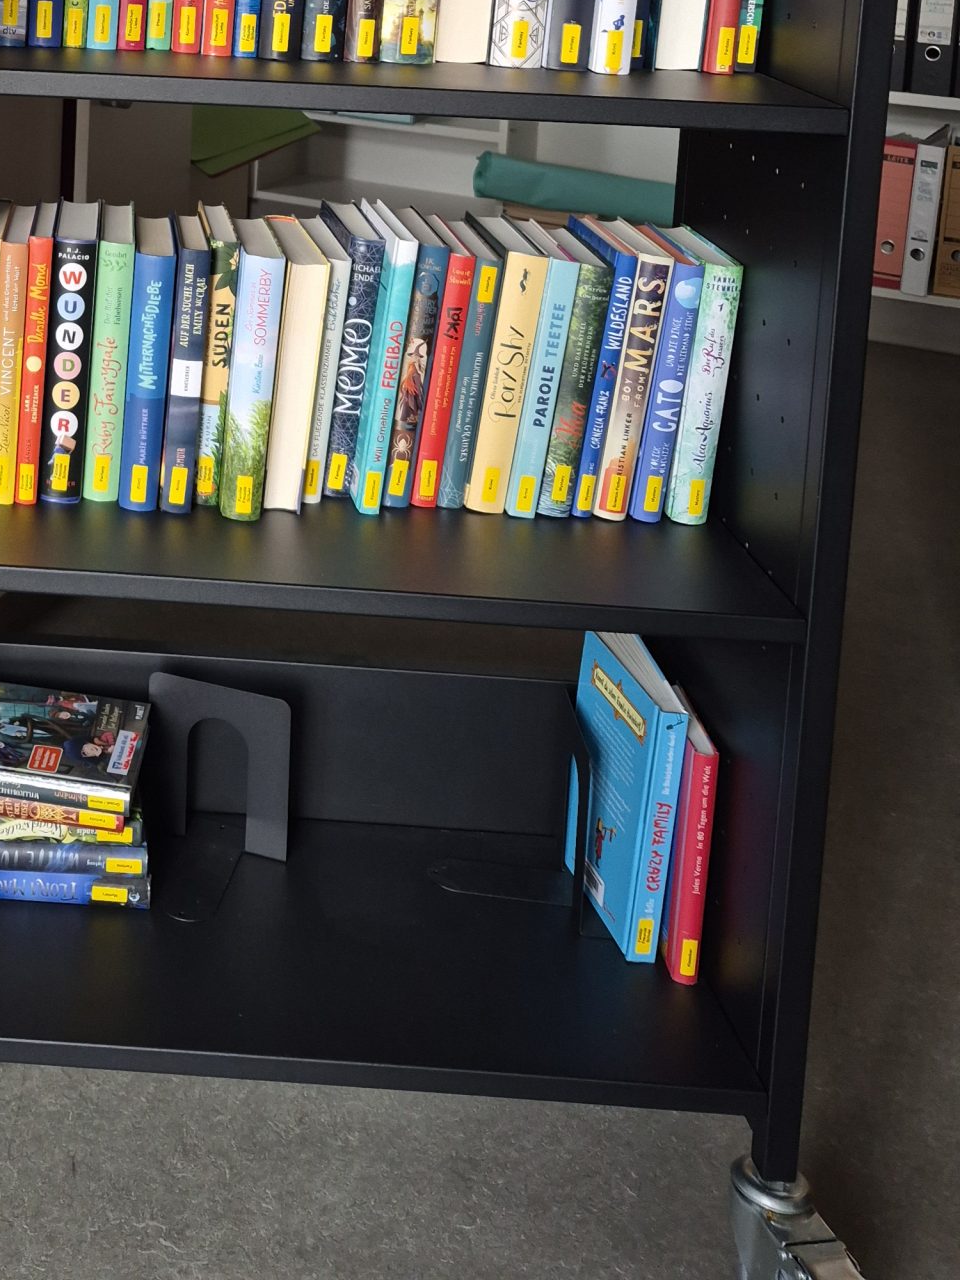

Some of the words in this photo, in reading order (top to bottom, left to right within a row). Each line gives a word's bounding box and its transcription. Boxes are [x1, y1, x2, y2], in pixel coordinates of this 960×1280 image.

[58, 253, 91, 261] PALACIO
[352, 263, 381, 274] MICHAEL
[183, 263, 195, 285] NACH
[353, 273, 375, 282] ENDE
[713, 275, 736, 284] TANYA
[181, 286, 193, 313] SUCHE
[253, 267, 273, 346] SOMMERBY
[604, 275, 632, 351] WILDESLAND
[179, 314, 191, 329] DER
[624, 276, 667, 374] MARS
[178, 330, 189, 348] AUF
[211, 302, 231, 369] SÜDEN
[497, 325, 525, 368] Shy
[0, 326, 16, 396] VINCENT
[334, 318, 373, 417] MOMO
[381, 320, 404, 390] FREIBAD
[532, 365, 556, 428] PAROLE
[544, 302, 567, 358] TEETEE
[319, 338, 333, 400] KLASSENZIMMER
[488, 370, 517, 422] Rory
[595, 389, 609, 416] FRANZ
[621, 376, 632, 402] BOY
[634, 375, 646, 409] FROM
[651, 378, 685, 433] CATO
[694, 391, 714, 445] Aquarius
[313, 402, 325, 442] FLIEGENDE
[375, 398, 391, 443] Gmehling
[591, 417, 605, 450] CORNELIA
[311, 442, 320, 457] DAS
[373, 446, 383, 463] Will
[703, 765, 712, 783] Welt
[701, 784, 709, 796] die
[701, 797, 708, 809] um
[697, 810, 708, 830] Tagen
[697, 831, 705, 841] 80
[645, 849, 665, 893] CRAZY
[693, 855, 703, 877] Verne
[691, 878, 701, 895] Jules
